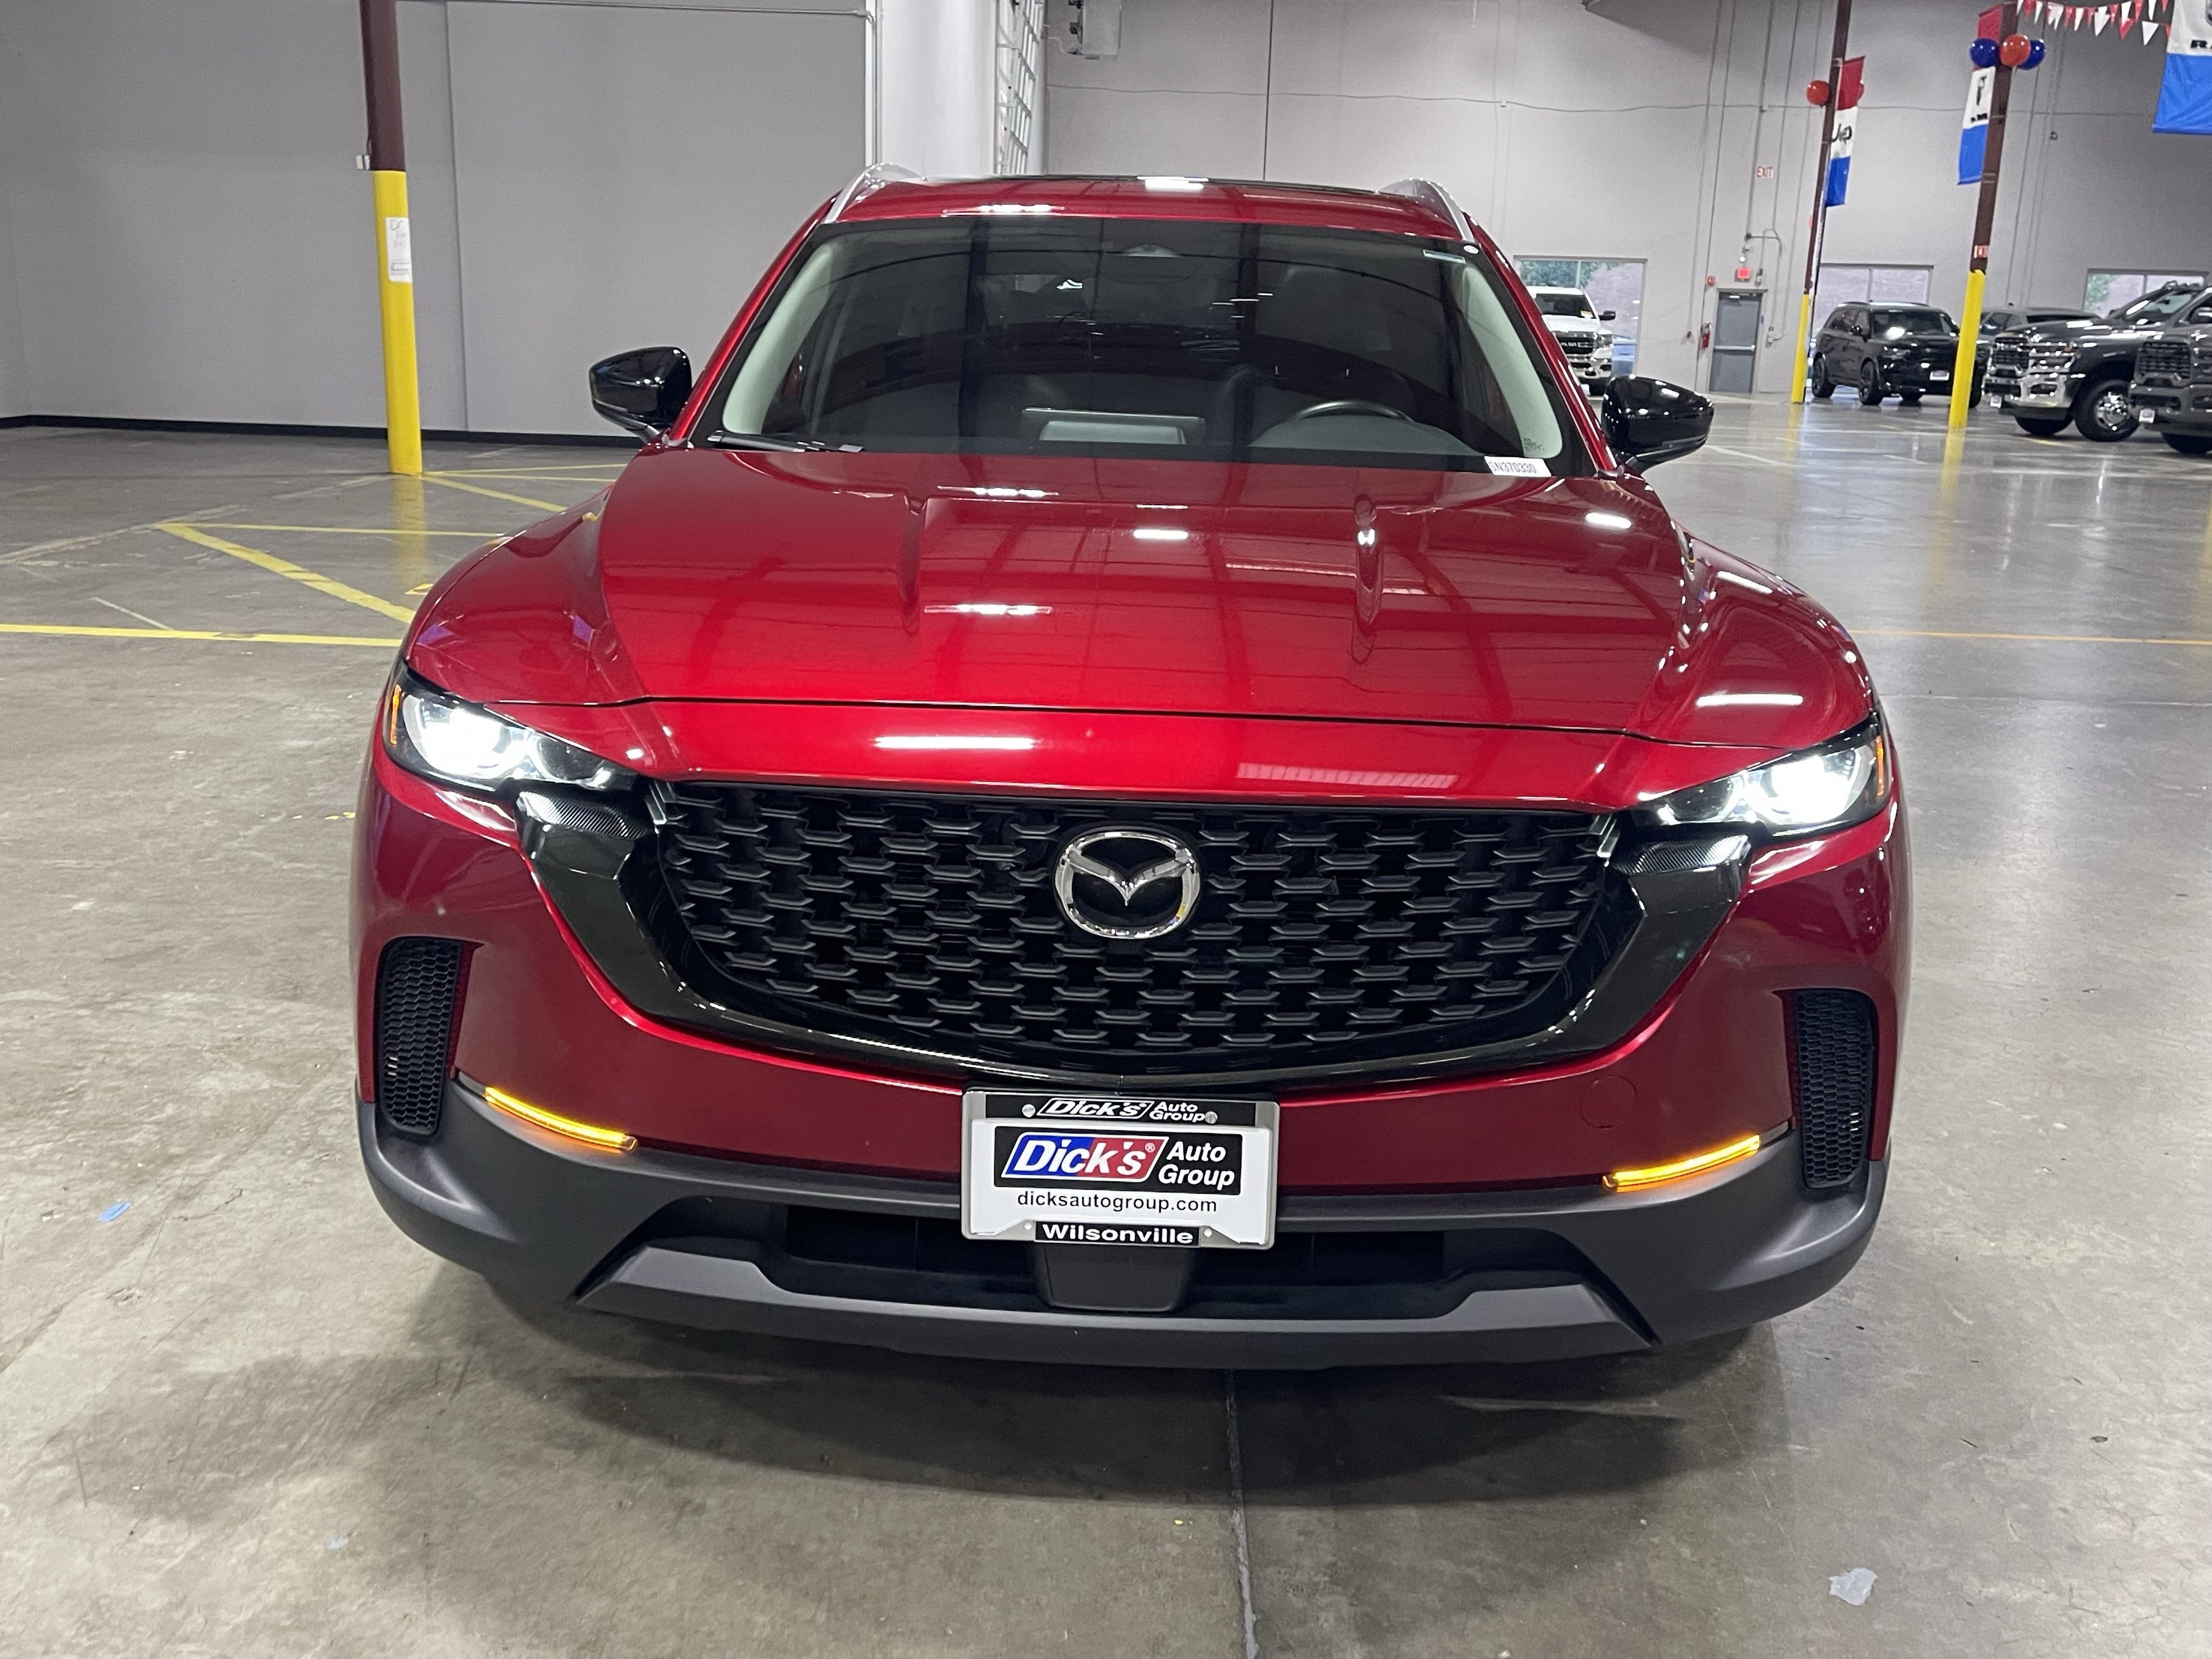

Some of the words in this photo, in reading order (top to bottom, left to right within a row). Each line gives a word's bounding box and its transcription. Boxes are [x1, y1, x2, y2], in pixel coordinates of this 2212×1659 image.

[1488, 461, 1537, 473] SN370330
[1149, 1110, 1205, 1122] Group
[1154, 1102, 1198, 1113] Auto
[1166, 1142, 1226, 1162] Auto
[1158, 1165, 1235, 1190] Group
[1018, 1191, 1217, 1213] dicksautogroup.com
[1042, 1224, 1193, 1244] Wilsonville
